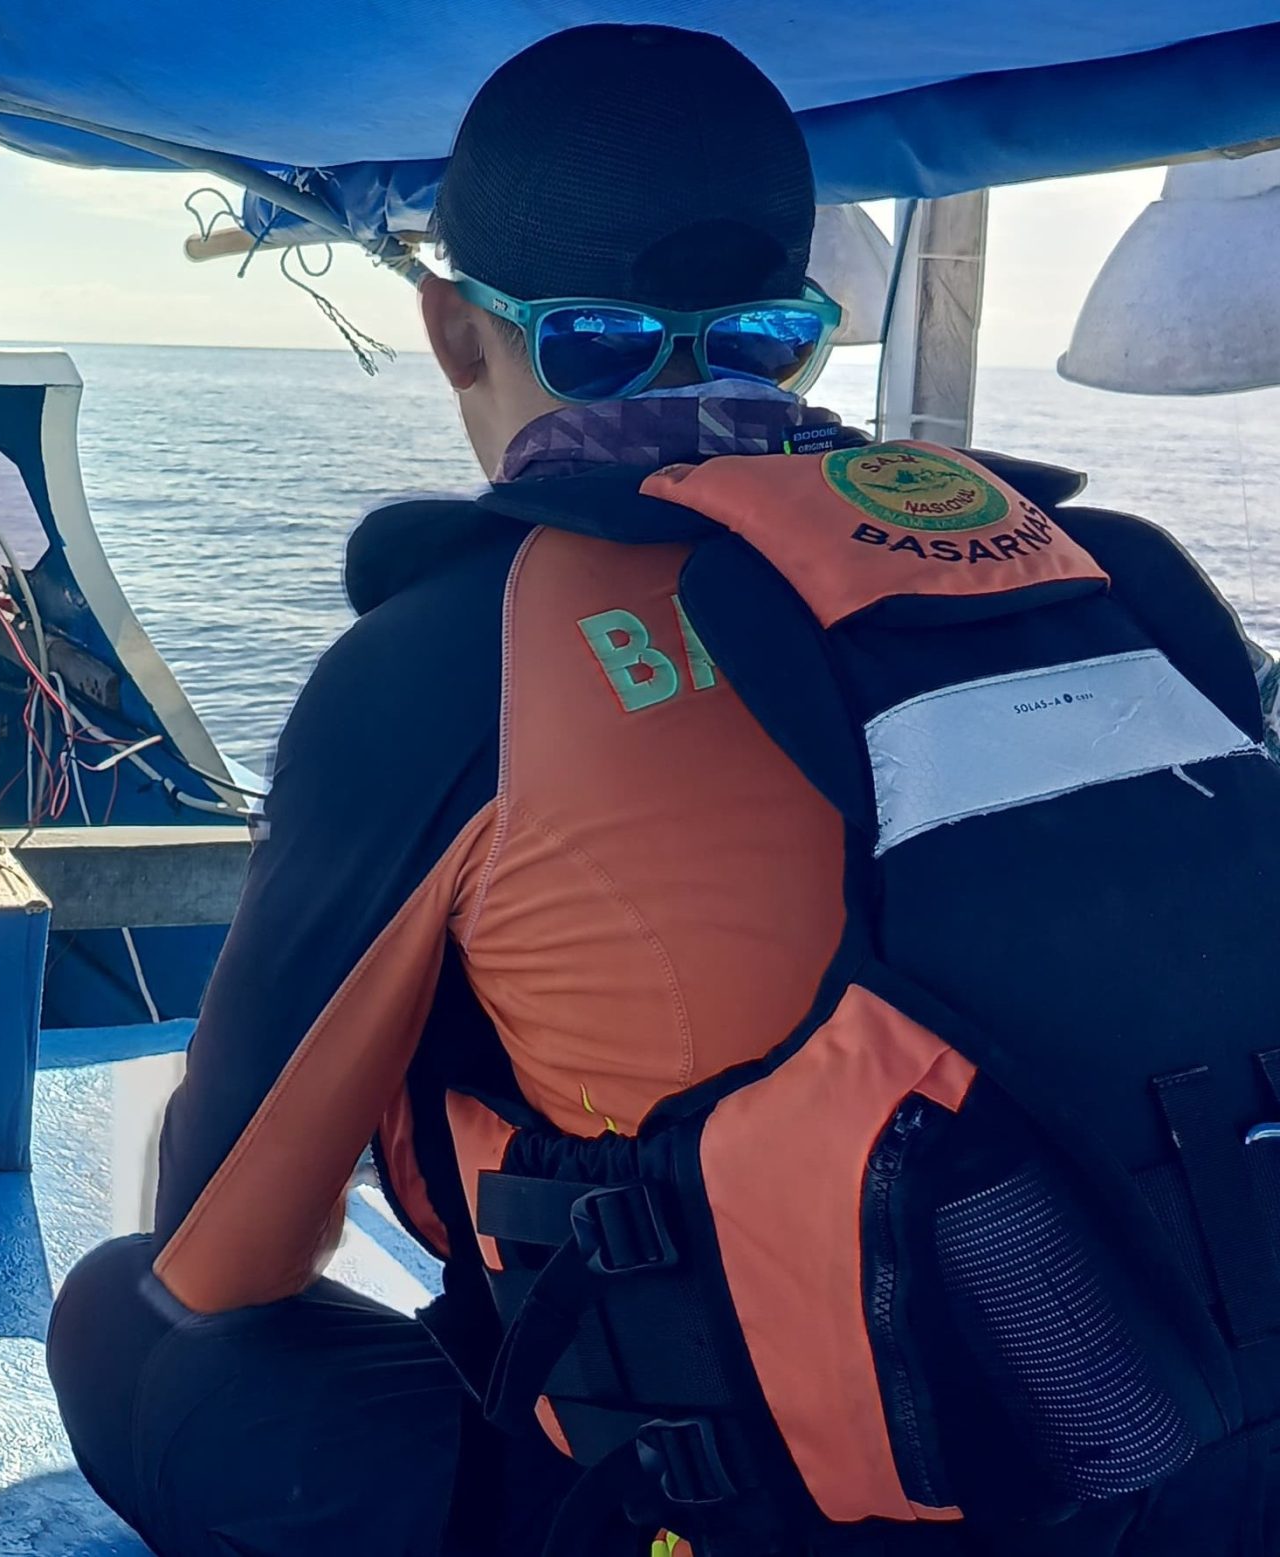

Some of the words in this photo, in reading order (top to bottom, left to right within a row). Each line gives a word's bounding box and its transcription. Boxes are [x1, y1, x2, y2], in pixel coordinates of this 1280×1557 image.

[904, 488, 976, 515] NASIONAL
[850, 501, 1053, 564] BASARNAS
[1013, 697, 1061, 714] SOLAS-A
